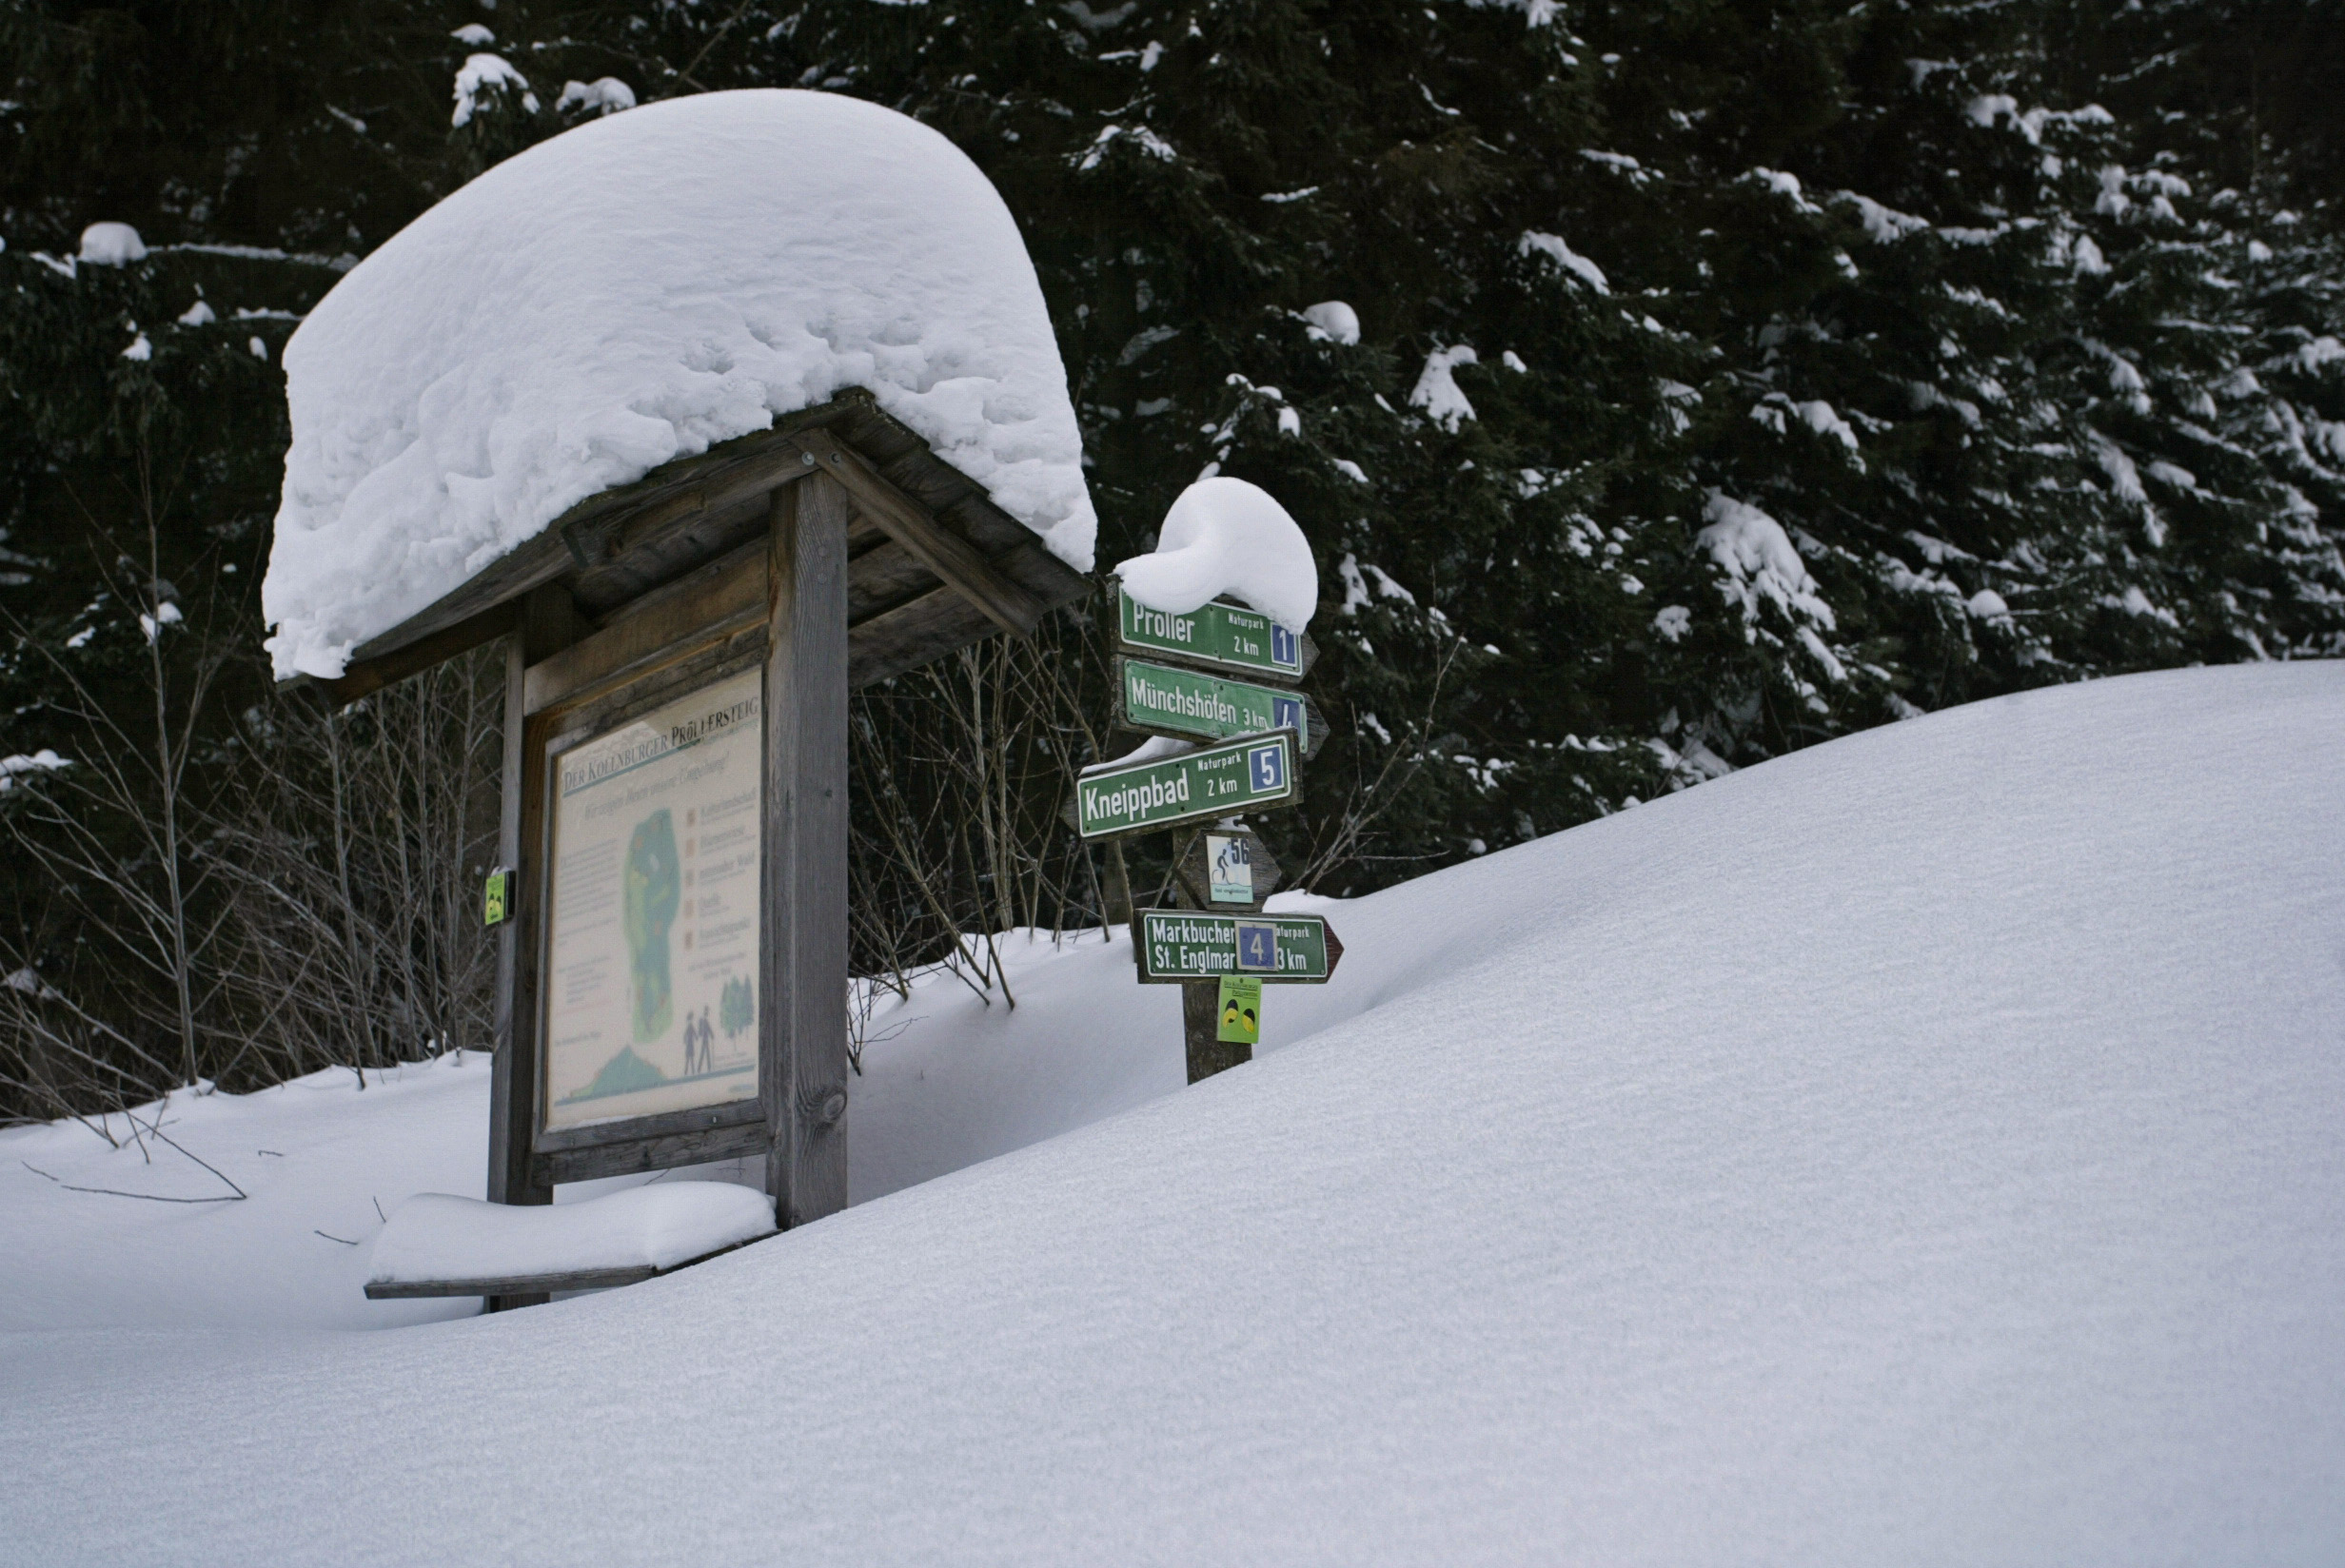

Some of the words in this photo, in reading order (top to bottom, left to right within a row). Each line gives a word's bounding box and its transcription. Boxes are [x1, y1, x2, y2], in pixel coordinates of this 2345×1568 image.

[1228, 612, 1264, 630] Naturpark
[1233, 636, 1241, 654] 2
[1243, 637, 1259, 657] km
[1279, 630, 1288, 661] 1
[1132, 676, 1237, 725] Münchshöfen
[1242, 707, 1251, 726] 3
[1251, 710, 1268, 729] km
[1197, 752, 1242, 773] Naturpark
[1260, 751, 1275, 786] 5
[563, 771, 585, 792] DER
[1085, 768, 1190, 822] Kneippbad
[1207, 778, 1215, 797] 2
[1218, 776, 1238, 795] km
[1231, 837, 1251, 865] 56
[1276, 926, 1310, 940] aturpark
[1154, 945, 1175, 970] St.
[1180, 945, 1235, 974] Englmar
[1250, 932, 1264, 964] 4
[1287, 948, 1307, 970] km
